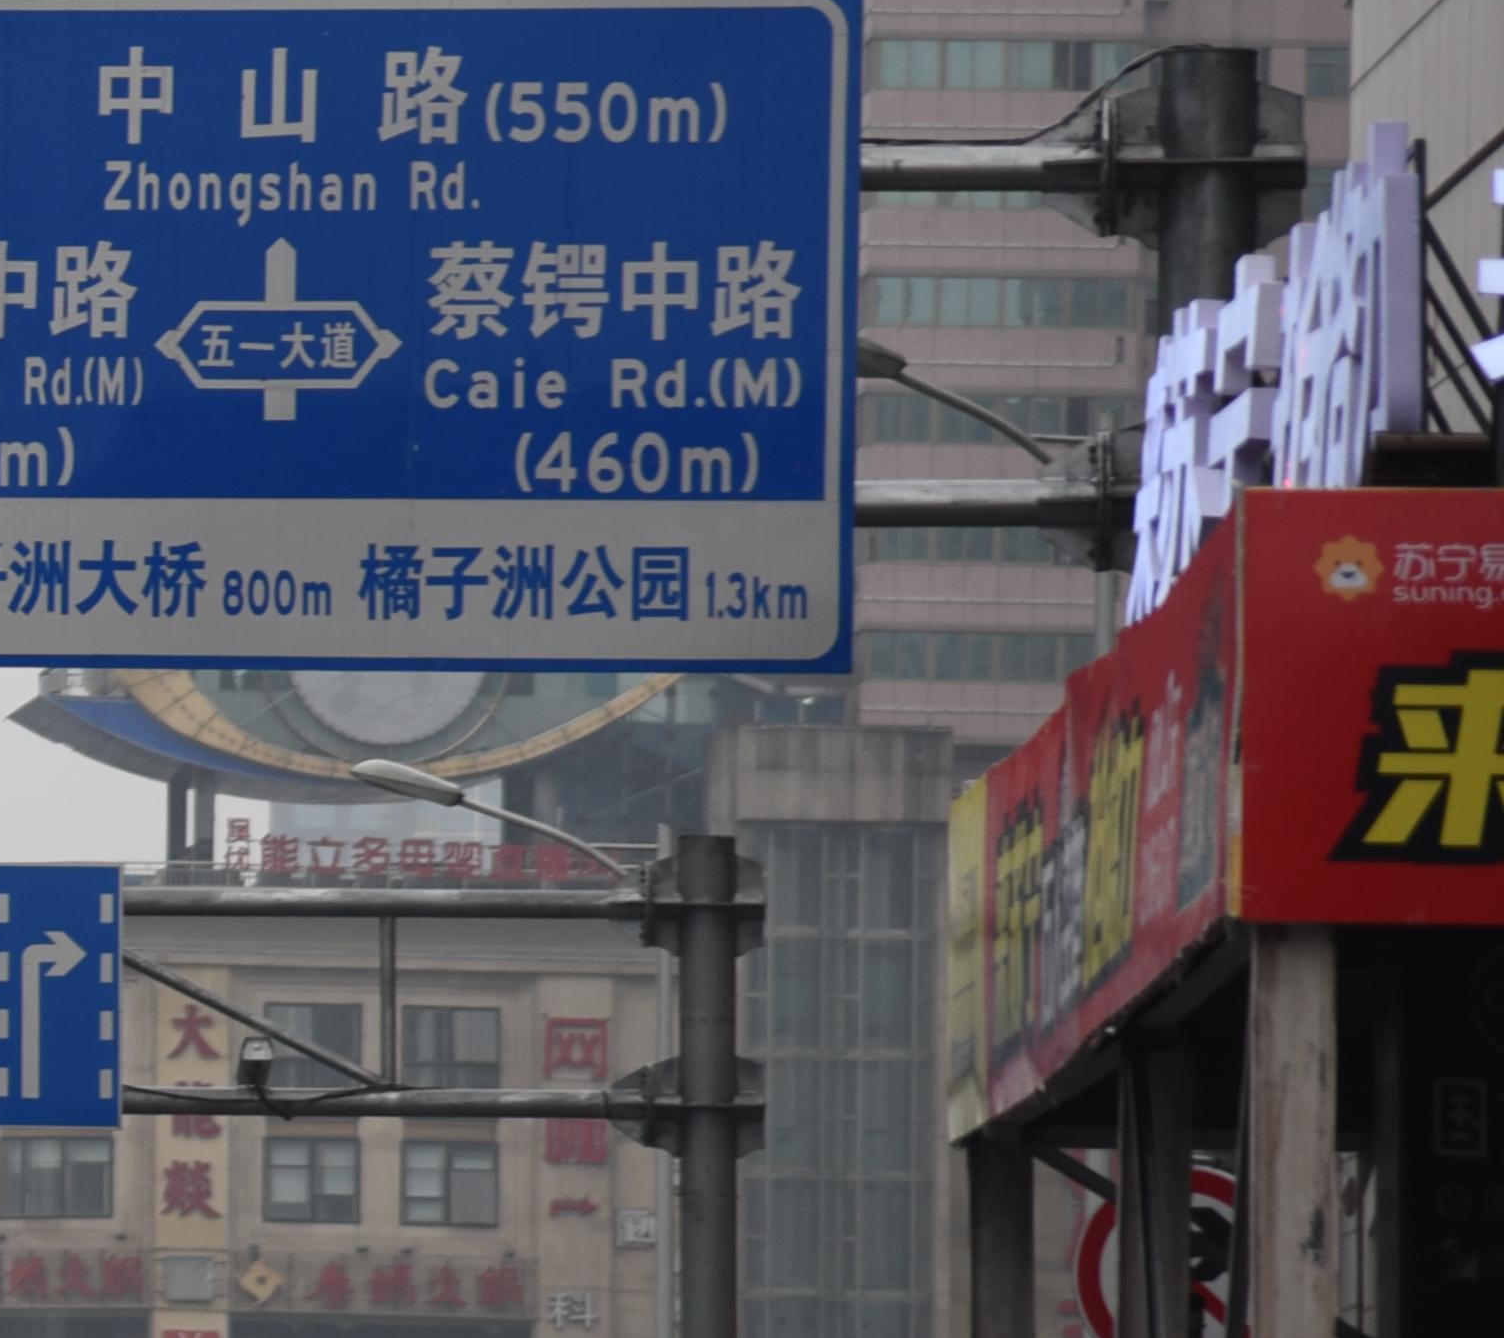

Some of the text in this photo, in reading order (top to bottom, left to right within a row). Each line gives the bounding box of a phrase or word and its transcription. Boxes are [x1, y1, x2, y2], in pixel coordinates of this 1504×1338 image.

[96, 46, 729, 145] 中山路 (550m)
[101, 161, 481, 227] Zhongshan Rd.
[425, 239, 803, 342] 蔡锷中路
[198, 322, 358, 371] 五一大道
[23, 355, 145, 407] Rd.(M)
[423, 357, 802, 411] Caie Rd.(M)
[513, 432, 760, 496] (460m)
[222, 569, 333, 618] 800m
[358, 543, 692, 622] 橘子洲公园
[705, 571, 809, 622] 1.3km
[1392, 583, 1504, 611] suning.
